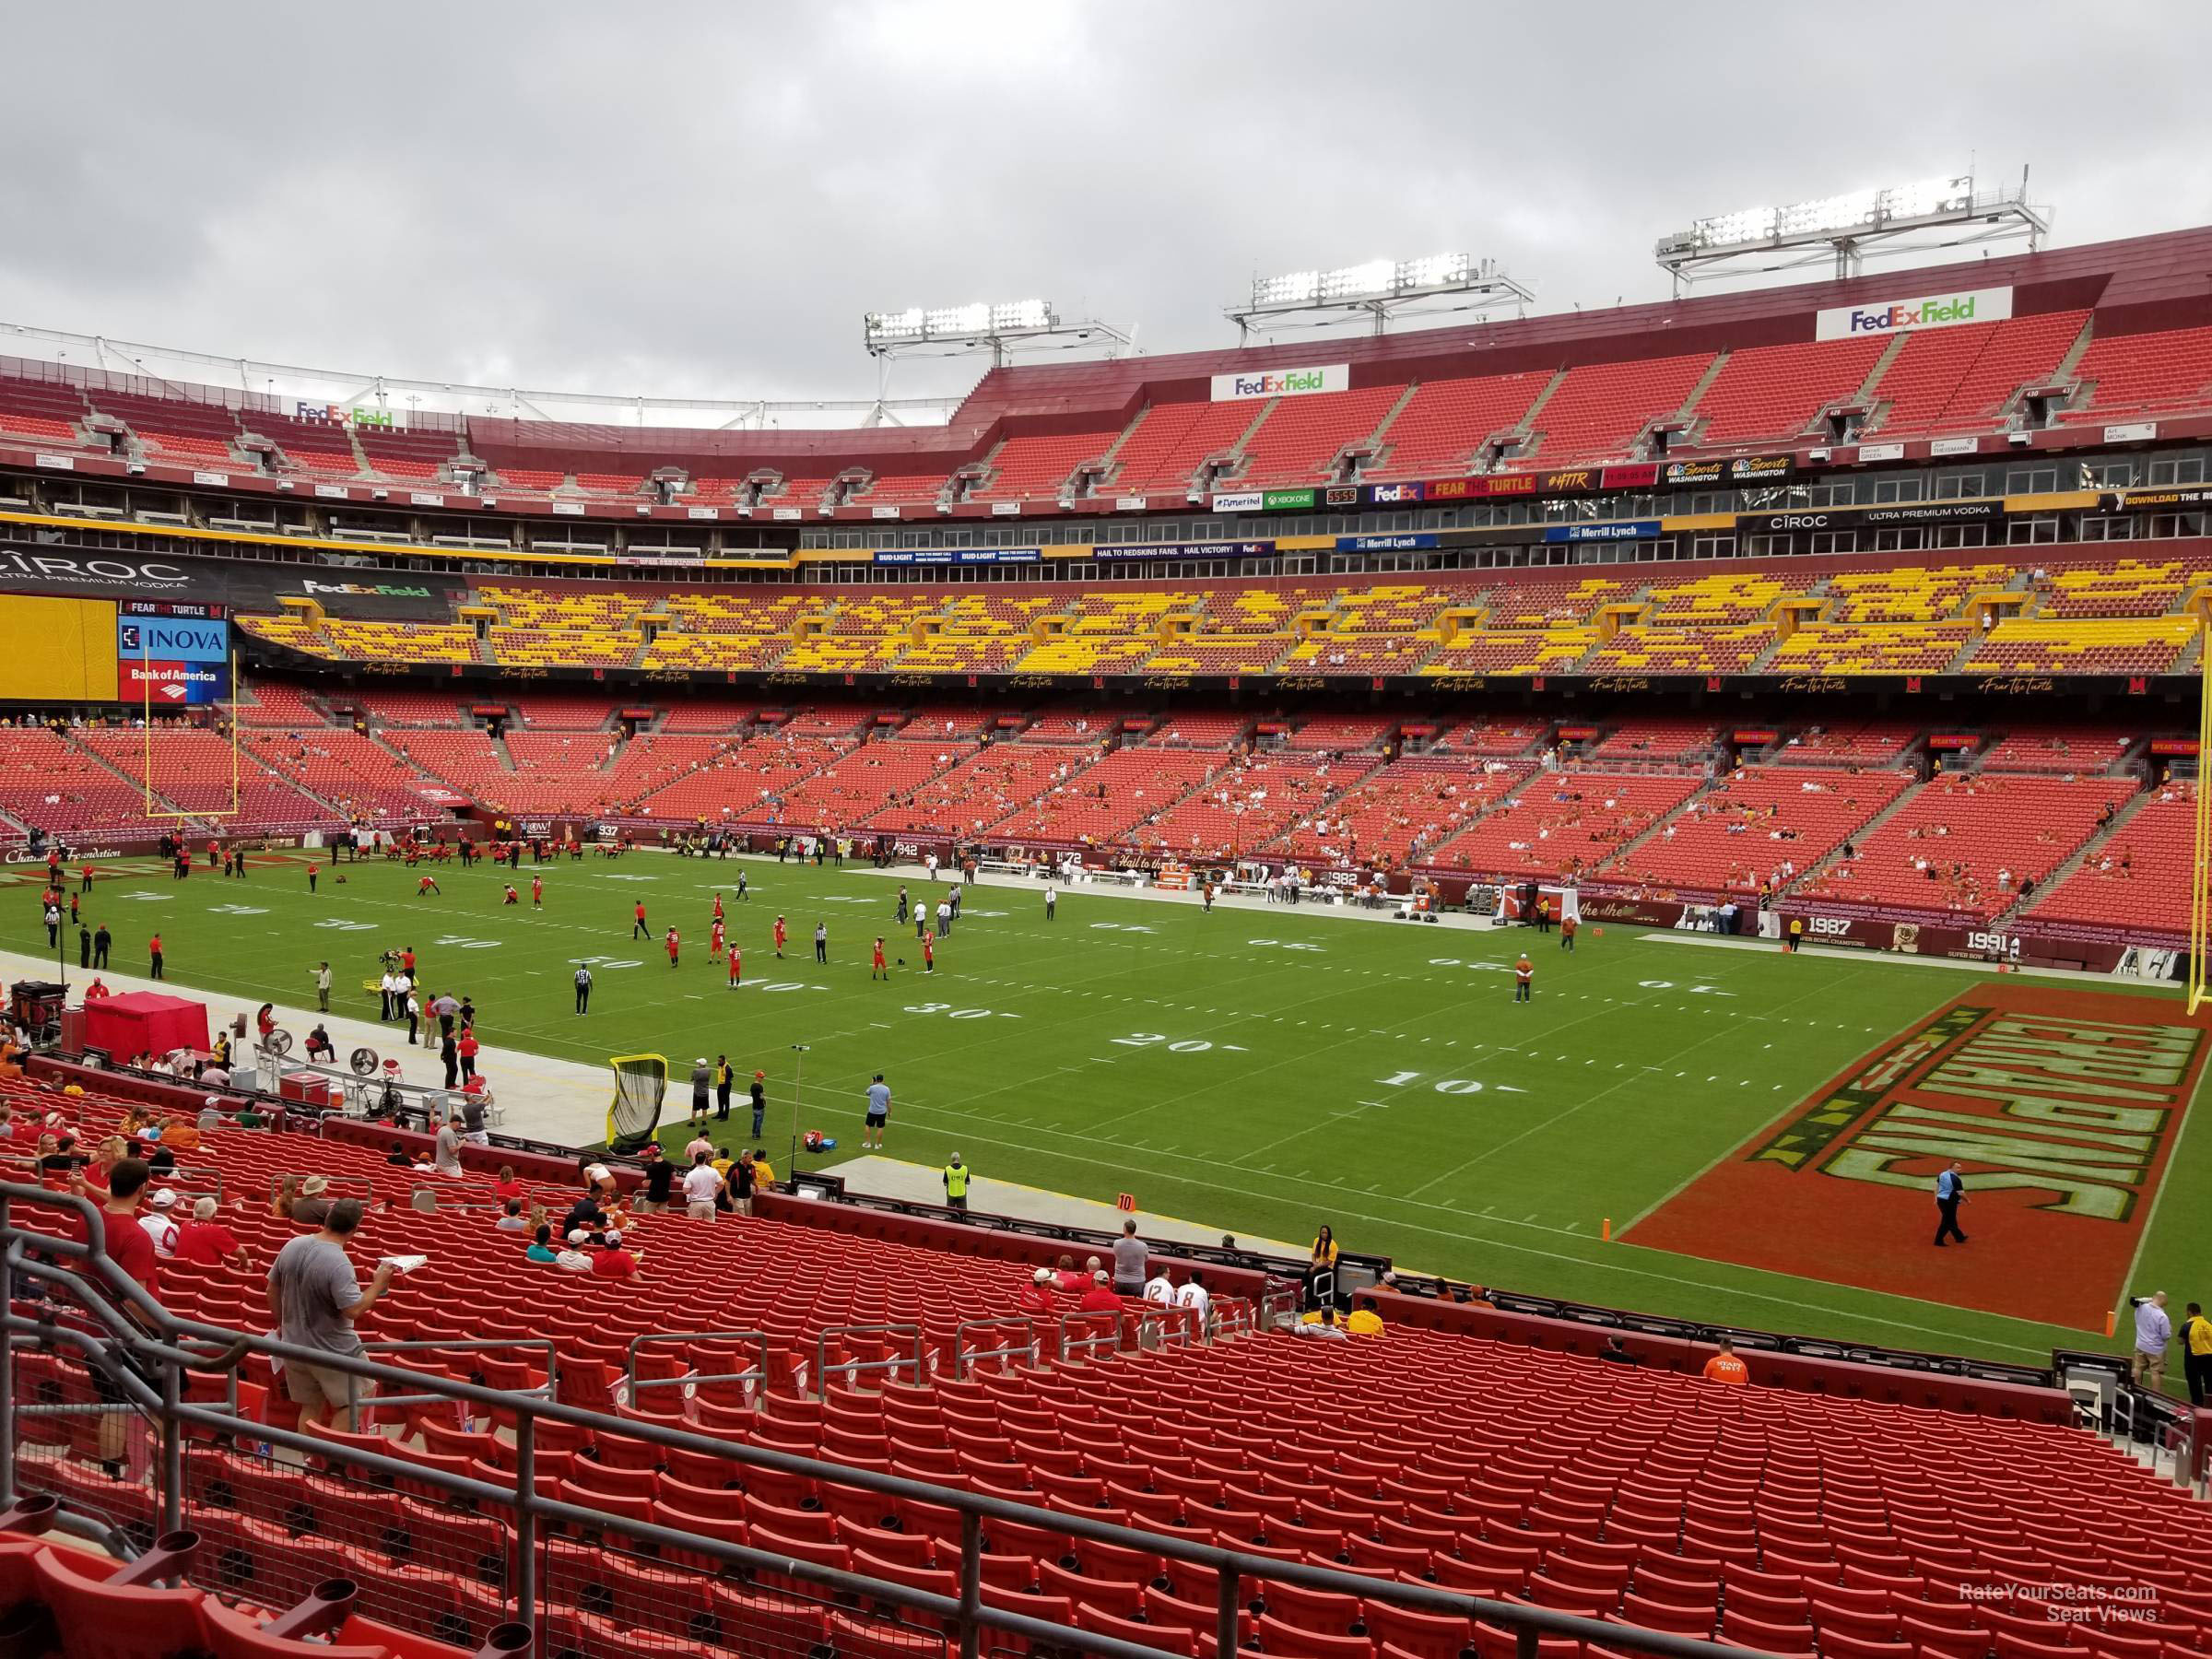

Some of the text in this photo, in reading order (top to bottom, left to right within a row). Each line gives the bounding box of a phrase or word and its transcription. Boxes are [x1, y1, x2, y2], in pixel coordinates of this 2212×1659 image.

[1851, 297, 1974, 332] FedExField
[1235, 371, 1323, 394] FedExField
[297, 402, 393, 427] FedExField
[1684, 463, 1723, 475] Sports
[1749, 457, 1790, 470] Sports
[1668, 474, 1720, 483] WASHINGTON
[1733, 470, 1786, 478] WASHINGTON
[1374, 486, 1418, 501] FedEx
[2125, 494, 2179, 505] DOWNLOAD
[2180, 493, 2199, 501] THE
[1869, 507, 1990, 521] ULTRA PREMIUM VODKA
[1581, 527, 1609, 537] Merrill
[1611, 525, 1637, 536] Lynch
[1367, 538, 1392, 547] Merrill
[1394, 537, 1416, 547] Lynch
[1201, 546, 1233, 554] VICTORY!
[0, 550, 190, 581] ÎROC
[44, 575, 127, 585] PREMIUM
[129, 581, 188, 589] VODKA
[302, 580, 430, 597] FedExField
[147, 629, 224, 651] INOVA
[131, 668, 217, 681] Bank of America
[2128, 677, 2146, 694] M
[599, 825, 618, 836] 937
[1119, 854, 1139, 868] Hail
[1141, 856, 1150, 868] to
[1809, 917, 1852, 935] 1987
[1968, 932, 2007, 952] 1991
[902, 1001, 993, 1019] 30
[1109, 1031, 1213, 1053] 20
[1373, 1070, 1483, 1094] 10
[1120, 1195, 1133, 1210] 10
[1148, 1284, 1162, 1301] 12
[1183, 1291, 1194, 1308] 8
